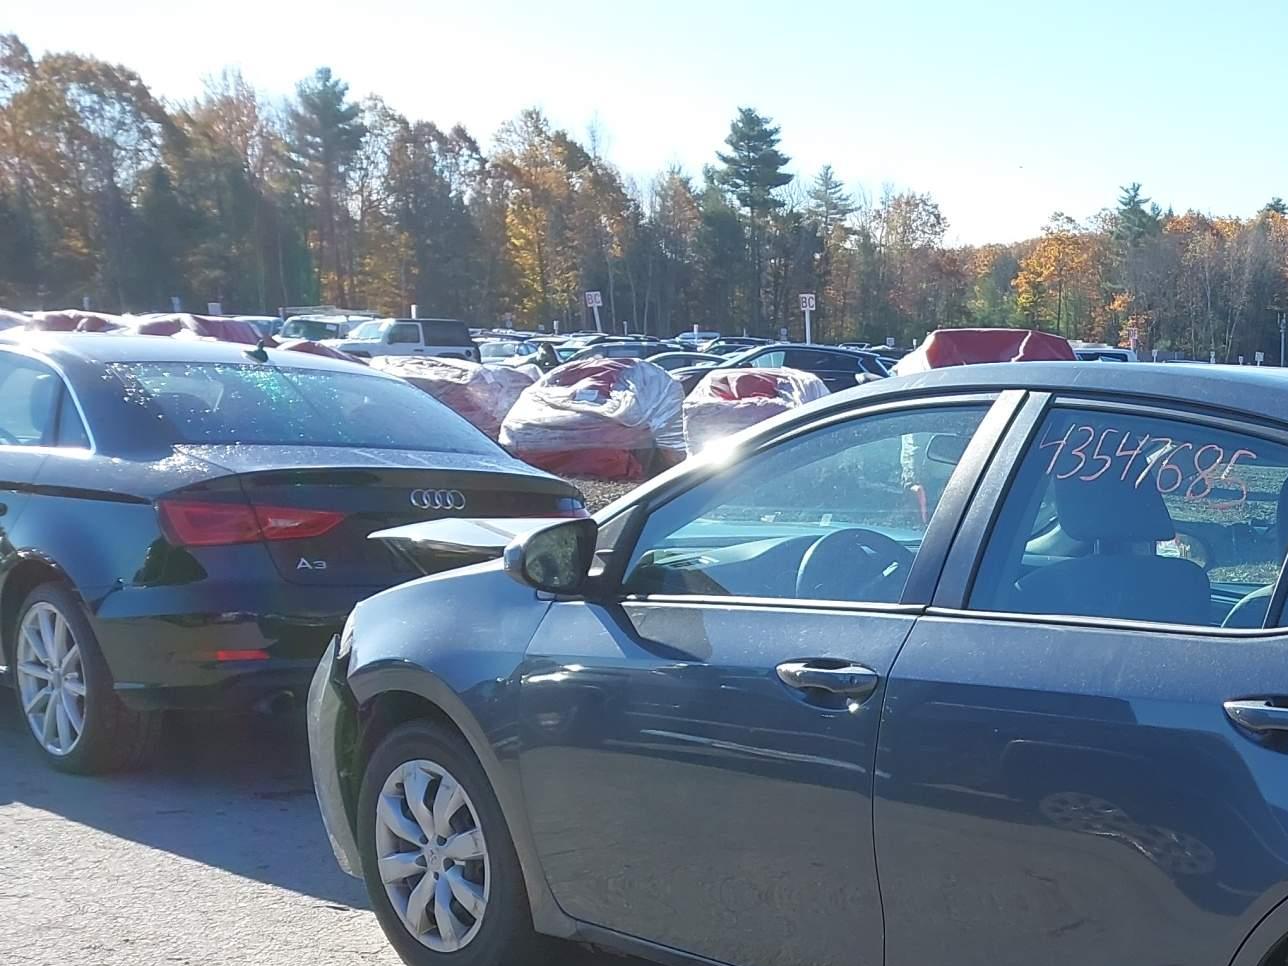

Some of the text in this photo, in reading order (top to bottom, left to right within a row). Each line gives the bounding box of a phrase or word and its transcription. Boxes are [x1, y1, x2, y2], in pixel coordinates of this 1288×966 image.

[587, 293, 601, 305] BC
[801, 296, 815, 308] BC
[1040, 424, 1257, 511] 43547685
[297, 558, 327, 569] A3
